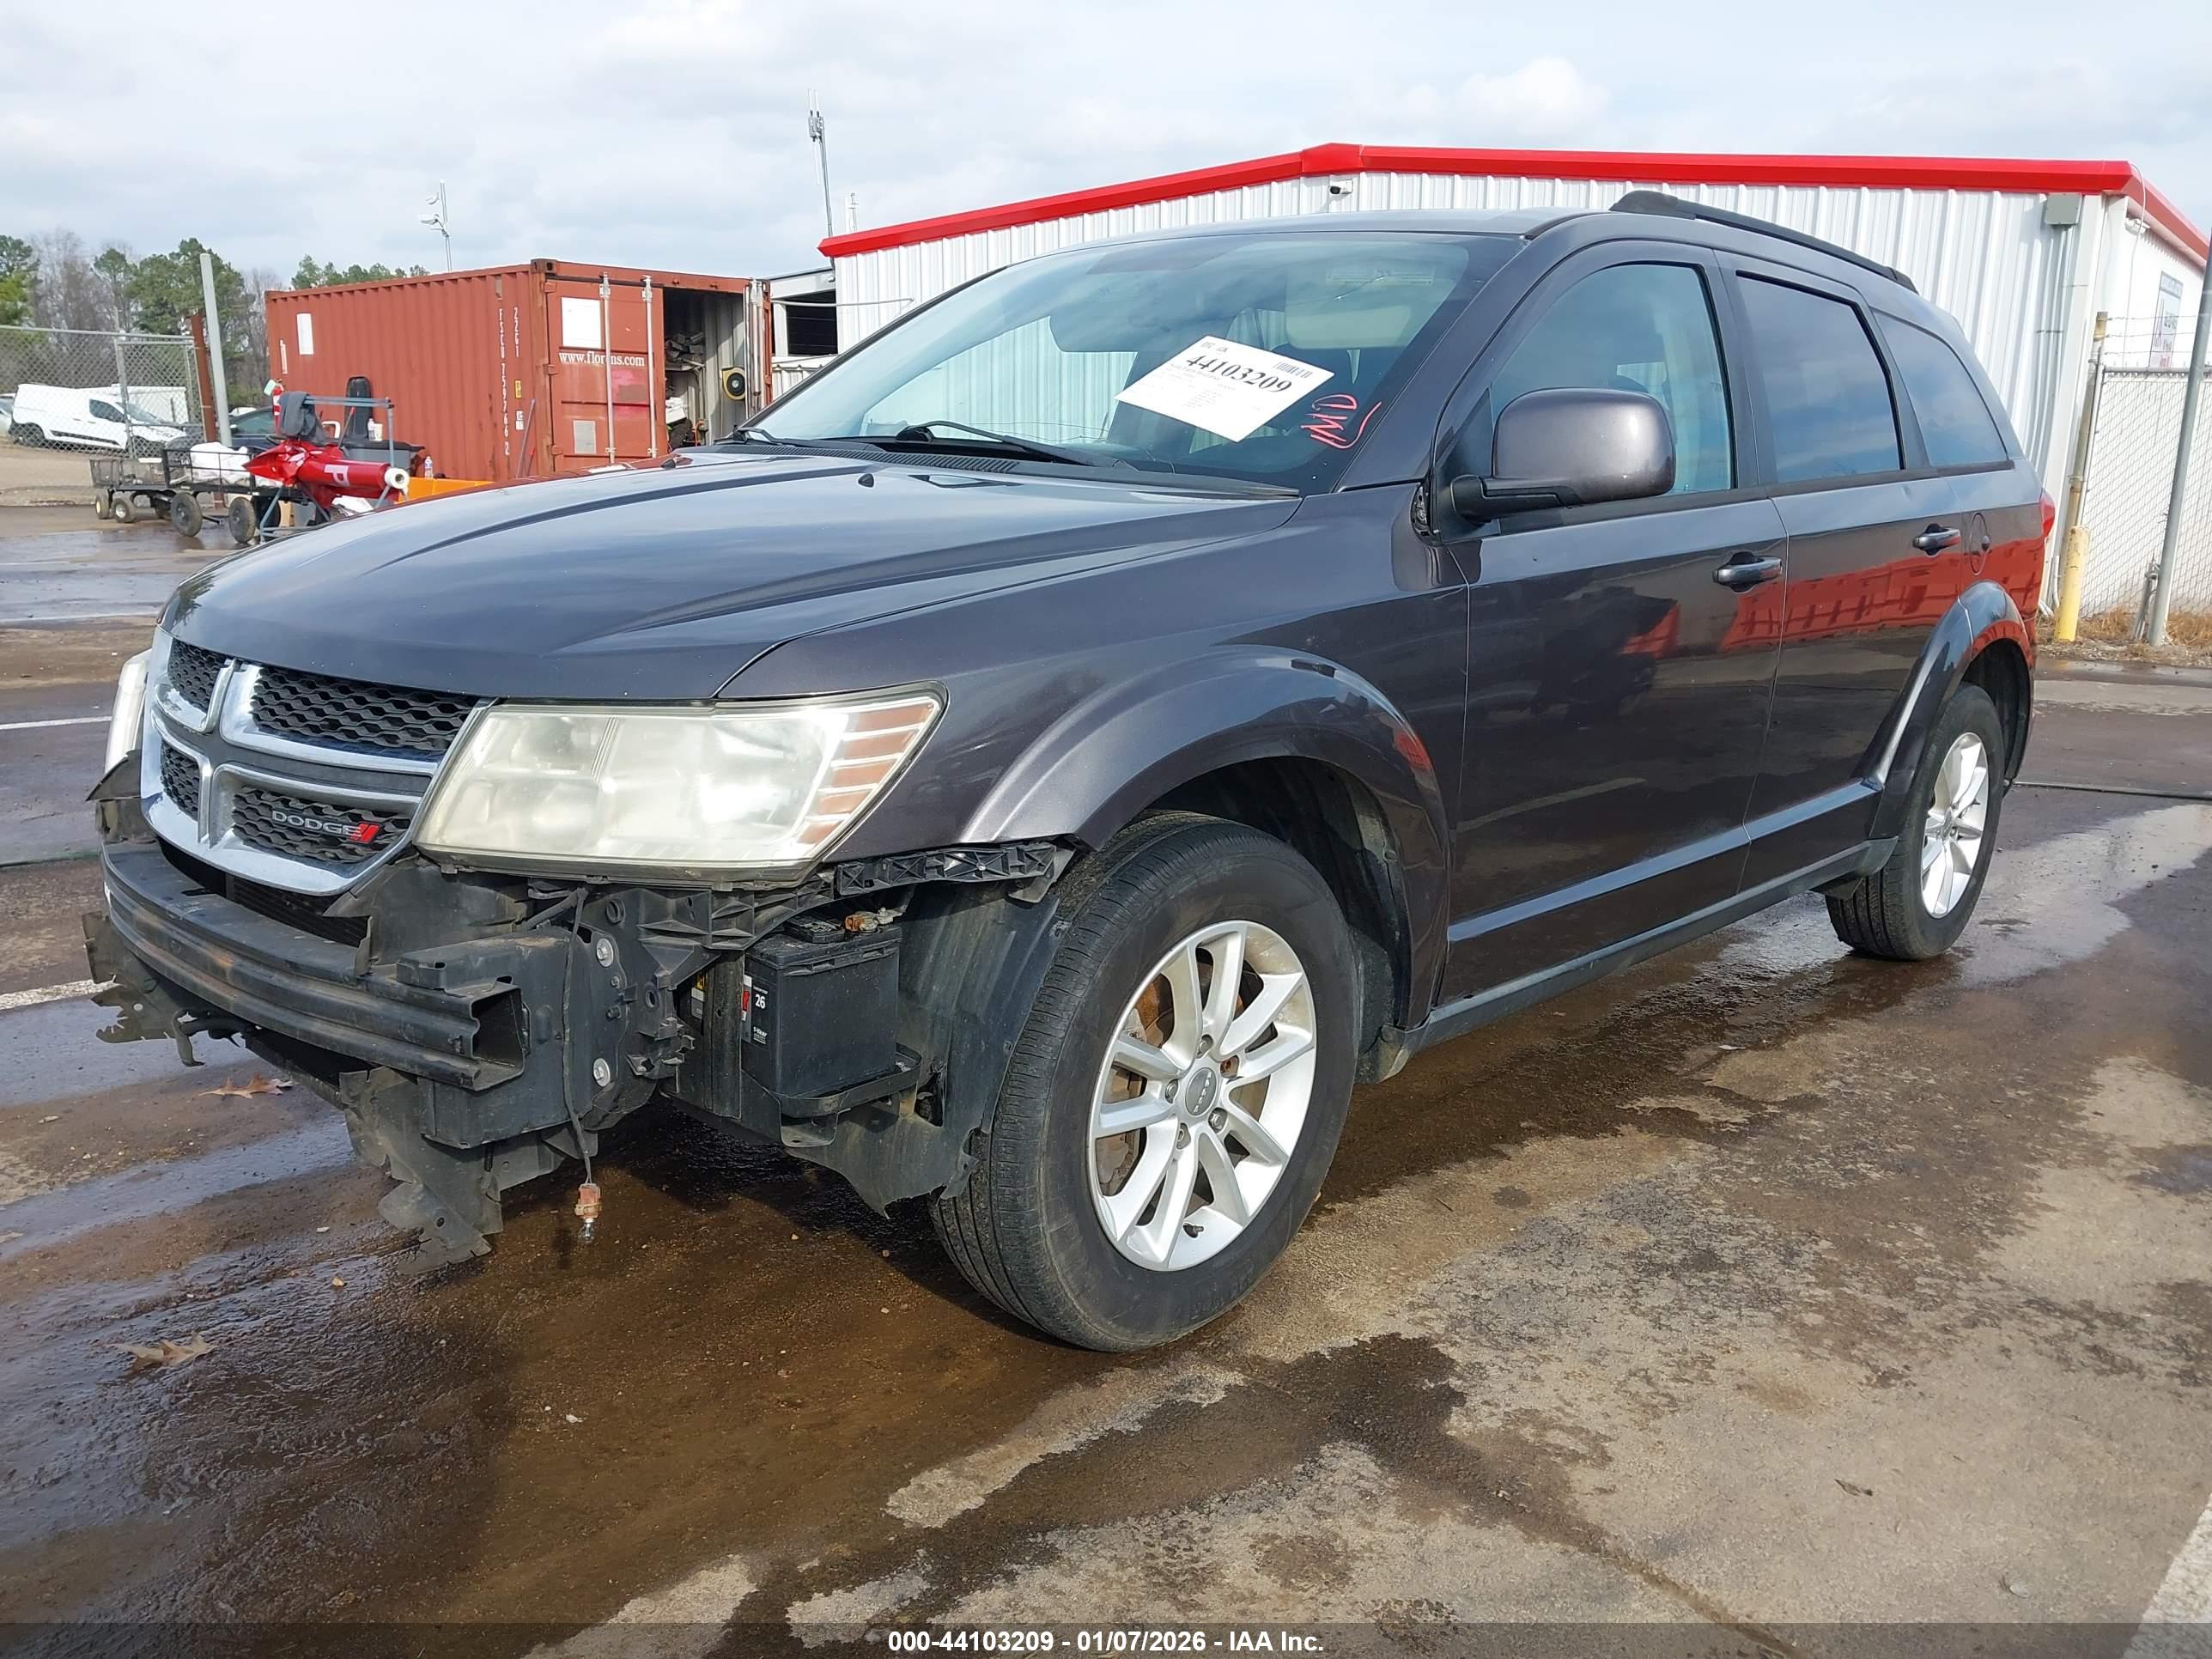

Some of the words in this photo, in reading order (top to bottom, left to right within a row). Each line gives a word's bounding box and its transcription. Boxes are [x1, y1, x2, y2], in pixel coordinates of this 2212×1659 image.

[558, 350, 646, 367] www.florns.com
[1186, 355, 1292, 392] 44103209
[271, 810, 362, 837] DODGE
[755, 993, 766, 1010] 26
